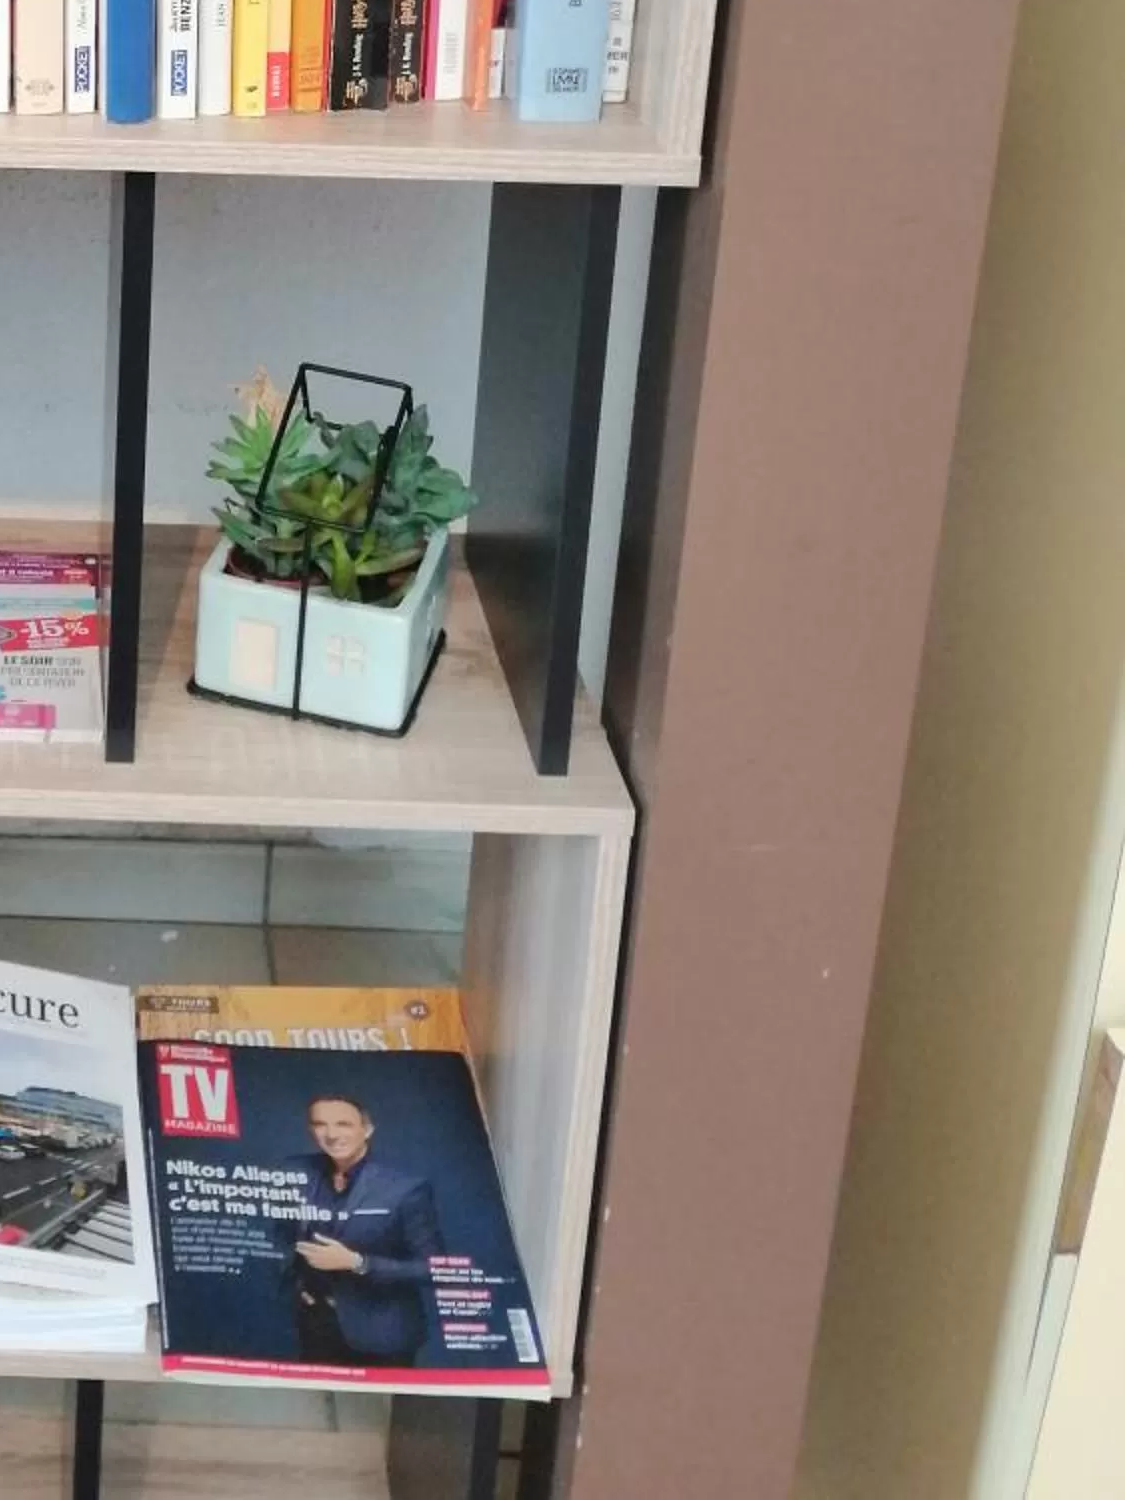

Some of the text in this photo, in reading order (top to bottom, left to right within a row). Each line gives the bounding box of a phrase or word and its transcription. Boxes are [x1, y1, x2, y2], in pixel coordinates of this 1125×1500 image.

[350, 0, 371, 29] Harry
[398, 0, 418, 25] Harry
[75, 48, 90, 93] POCKET
[171, 50, 187, 97] POCKET
[158, 1064, 230, 1122] TV
[163, 1118, 238, 1134] MAGAZINE
[165, 1159, 309, 1188] Nikos Aliagas
[183, 1178, 309, 1205] L'important,
[168, 1195, 221, 1213] c'est
[225, 1200, 257, 1218] ma
[262, 1201, 333, 1222] famille
